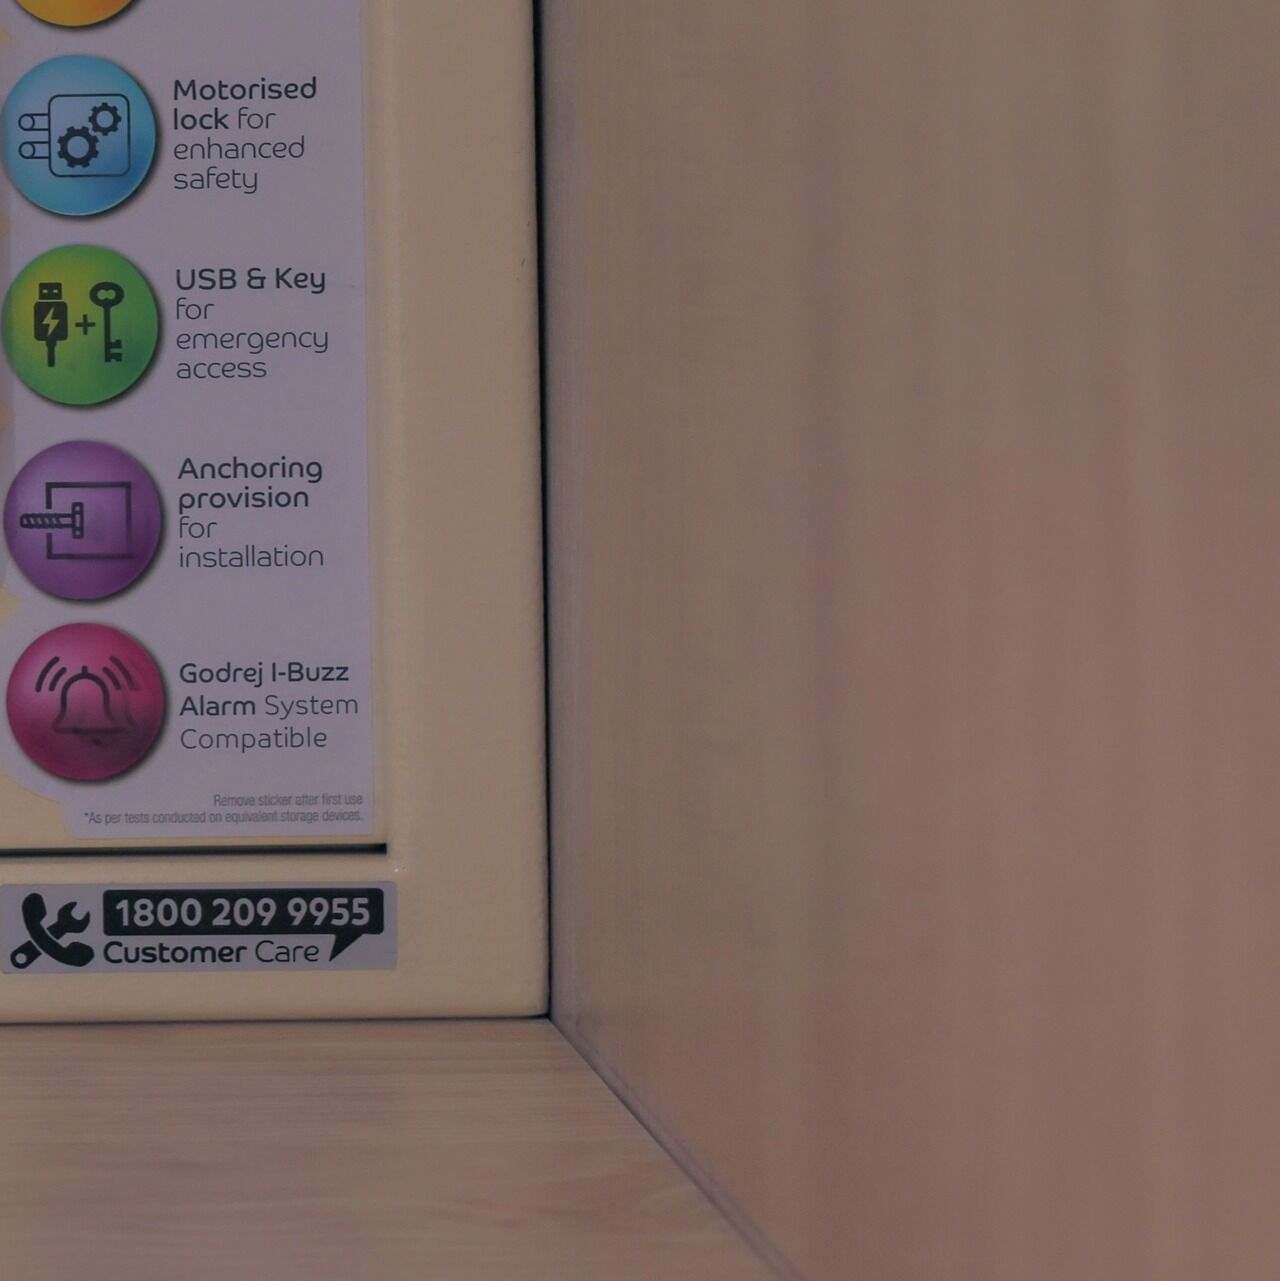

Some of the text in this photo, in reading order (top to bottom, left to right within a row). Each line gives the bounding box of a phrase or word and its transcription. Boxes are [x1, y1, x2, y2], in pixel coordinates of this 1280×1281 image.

[173, 77, 317, 100] Motorised
[173, 107, 277, 131] lock for
[173, 136, 306, 160] enhanced
[173, 166, 258, 195] safety
[175, 267, 327, 294] USB & Key
[175, 297, 215, 320] for
[176, 330, 329, 354] emergency
[176, 361, 268, 379] access
[178, 456, 323, 483] Anchoring
[179, 486, 309, 514] provision
[179, 516, 218, 538] for
[179, 545, 324, 568] installation
[179, 662, 350, 688] Godrej I-Buzz
[180, 695, 359, 720] Alarm System
[180, 727, 328, 753] Compatible
[214, 794, 363, 806] Remove sticker after first use
[105, 814, 122, 826] per
[124, 812, 150, 824] tests
[152, 812, 206, 824] conducted
[208, 814, 223, 823] on
[225, 811, 278, 825] equivalent
[281, 811, 319, 825] storage
[115, 897, 370, 927] 1800 209 9955
[103, 940, 320, 964] Customer Care
